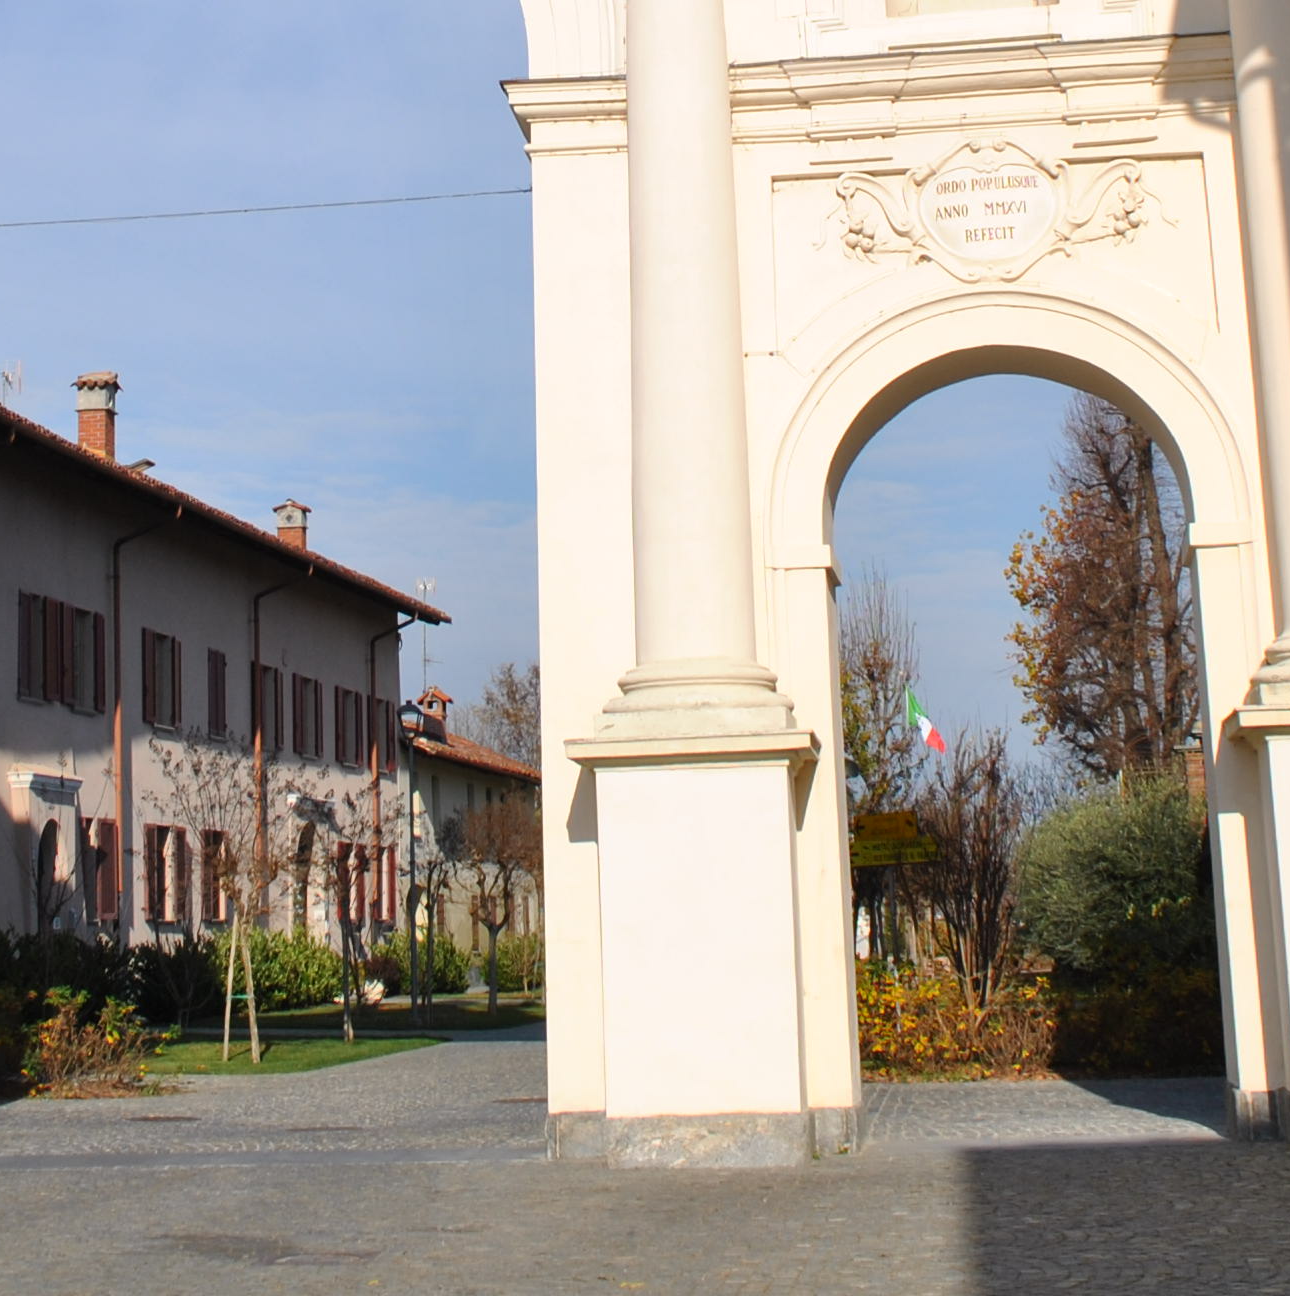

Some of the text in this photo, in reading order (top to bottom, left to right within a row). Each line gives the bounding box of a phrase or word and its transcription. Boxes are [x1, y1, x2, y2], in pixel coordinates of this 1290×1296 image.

[936, 175, 1038, 195] ORDO POPULUSQUE
[935, 200, 1027, 223] ANNO MMXVI
[964, 226, 1015, 244] REFECIT
